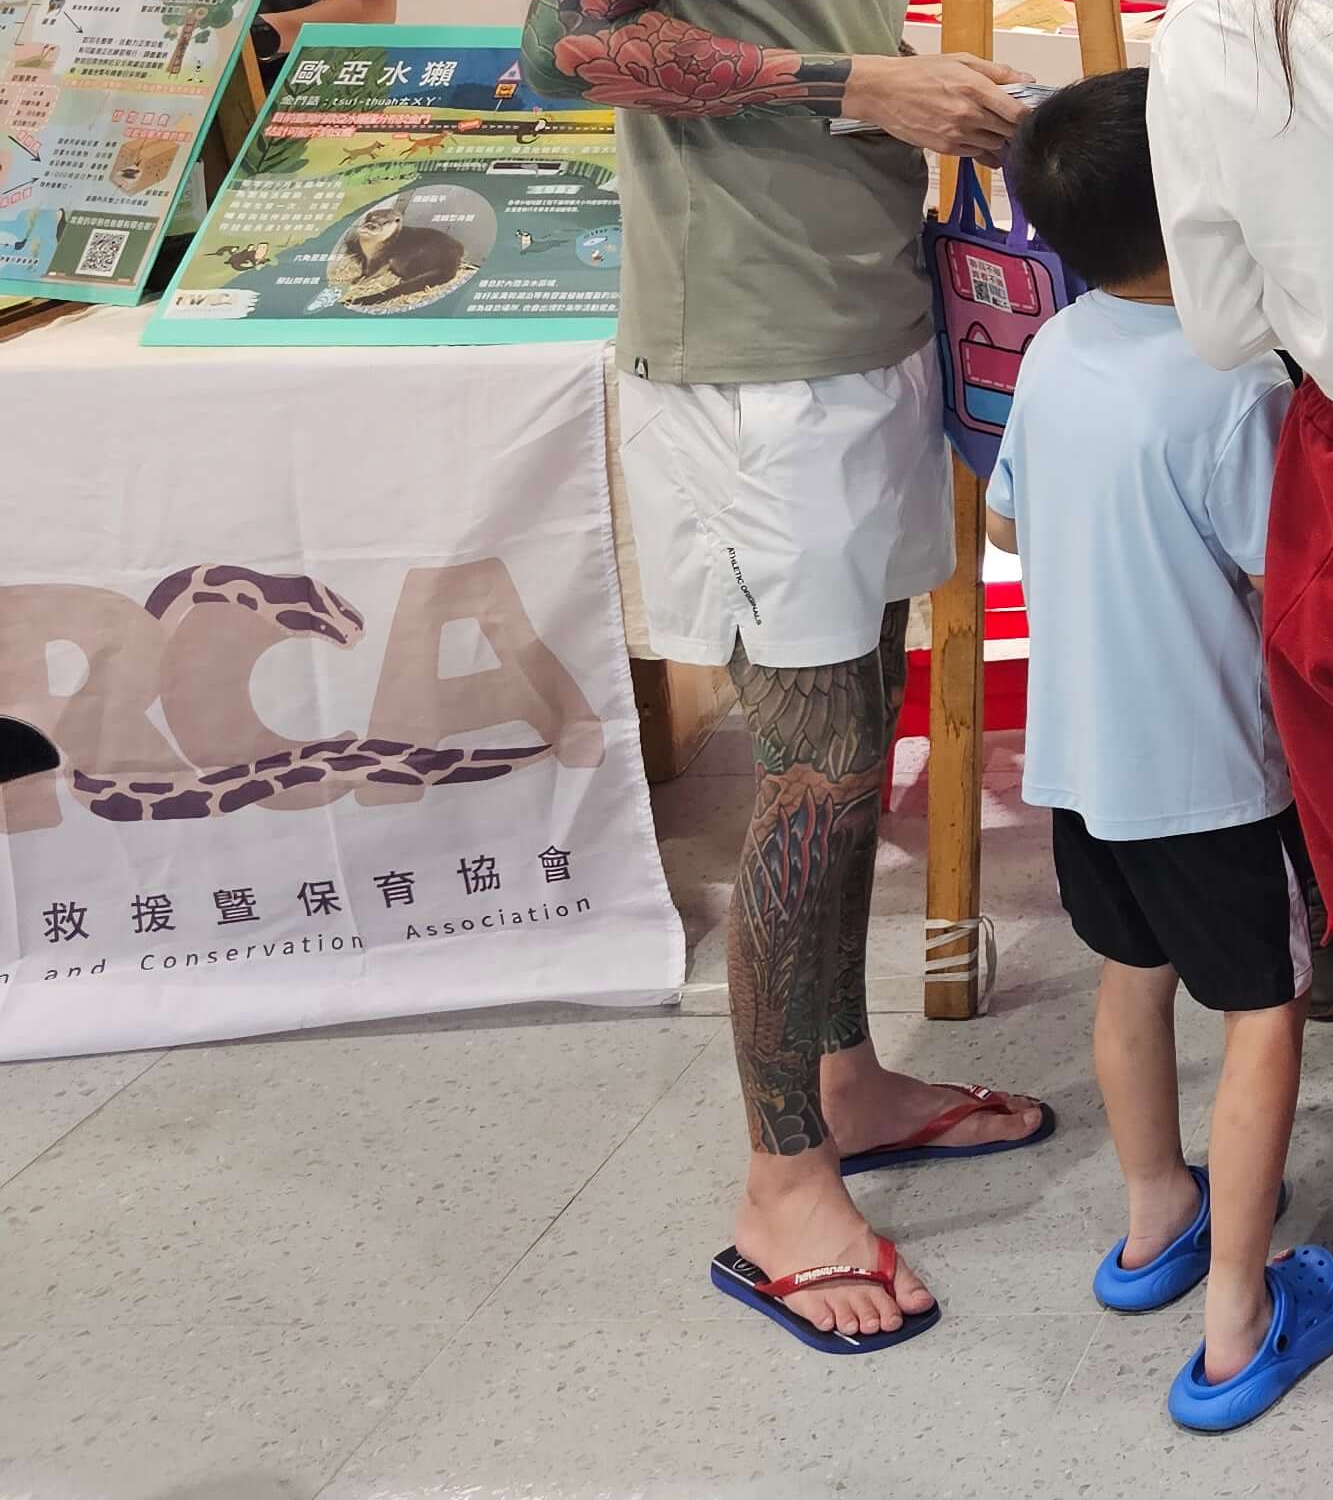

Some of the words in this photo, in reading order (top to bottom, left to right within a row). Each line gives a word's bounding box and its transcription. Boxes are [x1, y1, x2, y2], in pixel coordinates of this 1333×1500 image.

[290, 60, 458, 87] 歐亞水獺
[43, 845, 572, 943] 救援暨保育協會
[45, 957, 107, 982] and
[139, 933, 364, 972] Conservation
[405, 896, 591, 940] Association
